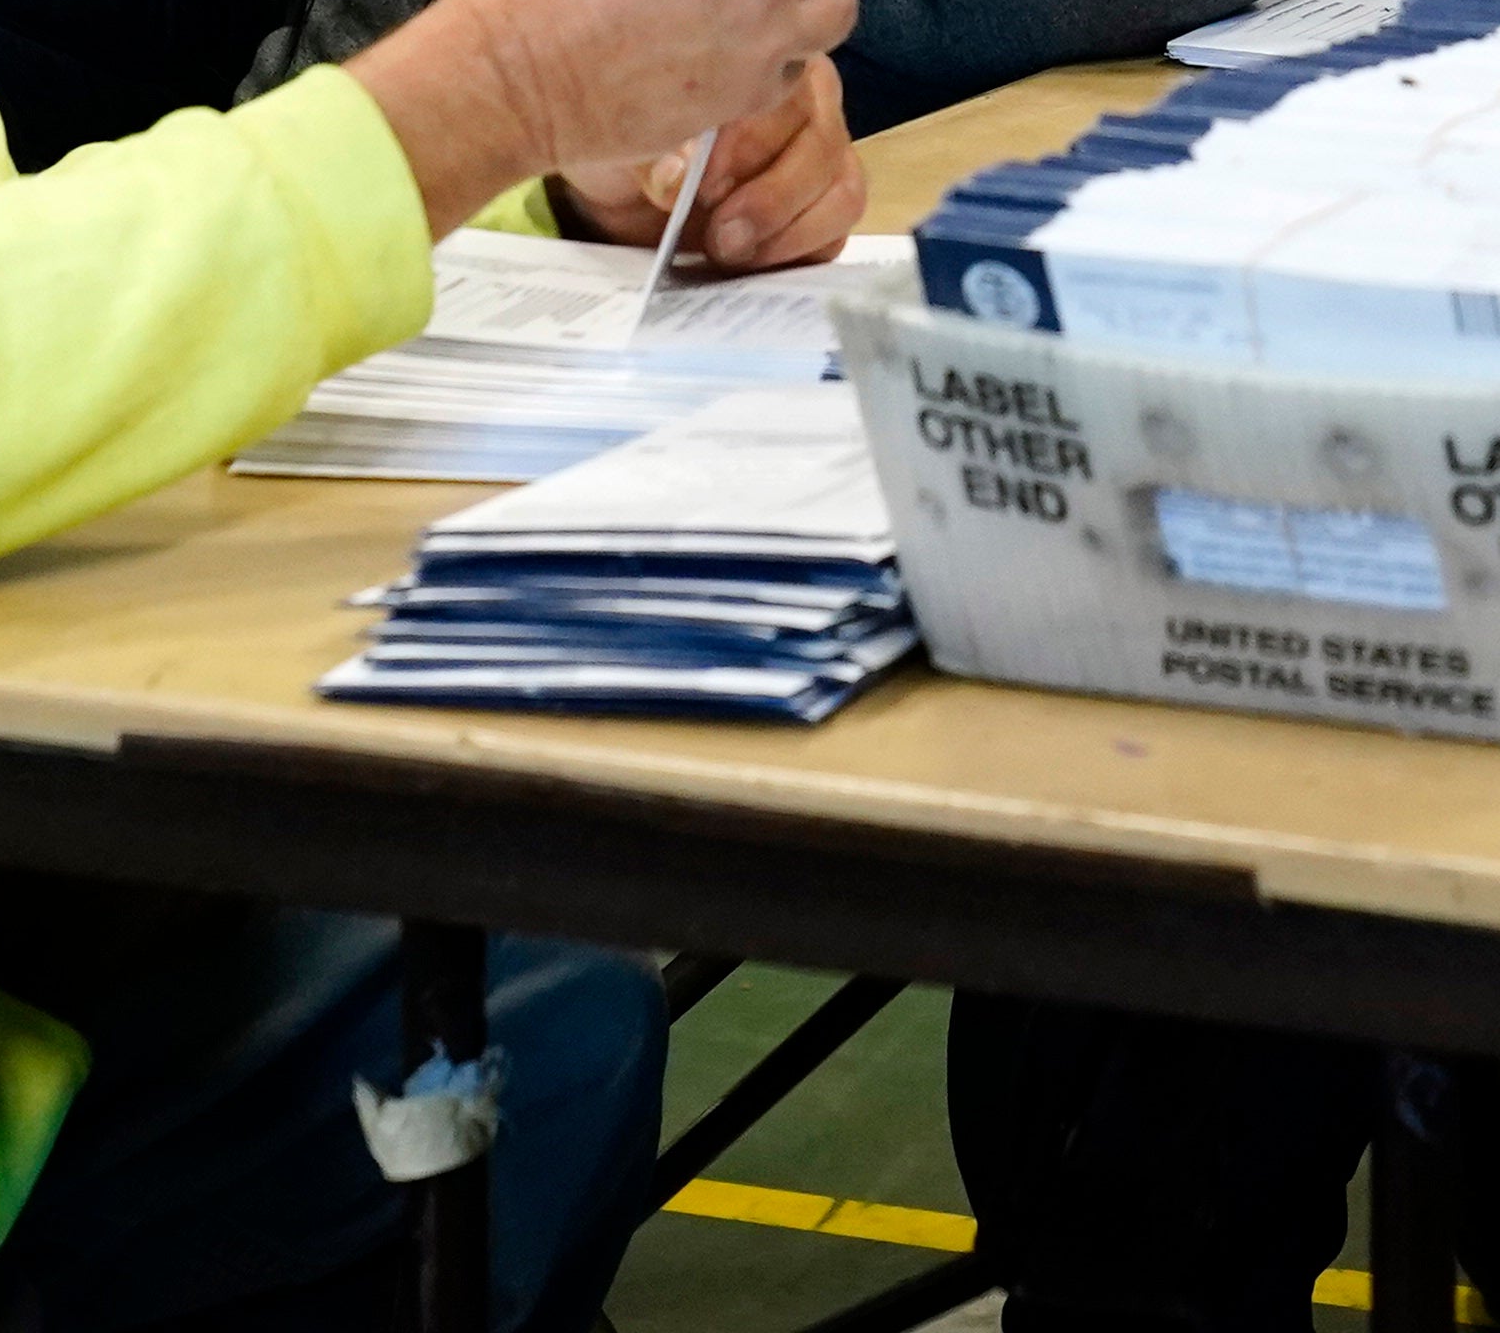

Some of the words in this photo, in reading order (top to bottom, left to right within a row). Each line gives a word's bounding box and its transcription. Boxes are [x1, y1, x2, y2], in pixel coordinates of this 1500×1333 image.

[909, 358, 1080, 433] LABEL
[915, 406, 1094, 482] OTHER
[960, 464, 1070, 524] END
[1164, 616, 1310, 660] UNITED
[1320, 629, 1472, 679] STATES
[1162, 650, 1316, 700] POSTAL
[1326, 674, 1496, 722] SERVICE
